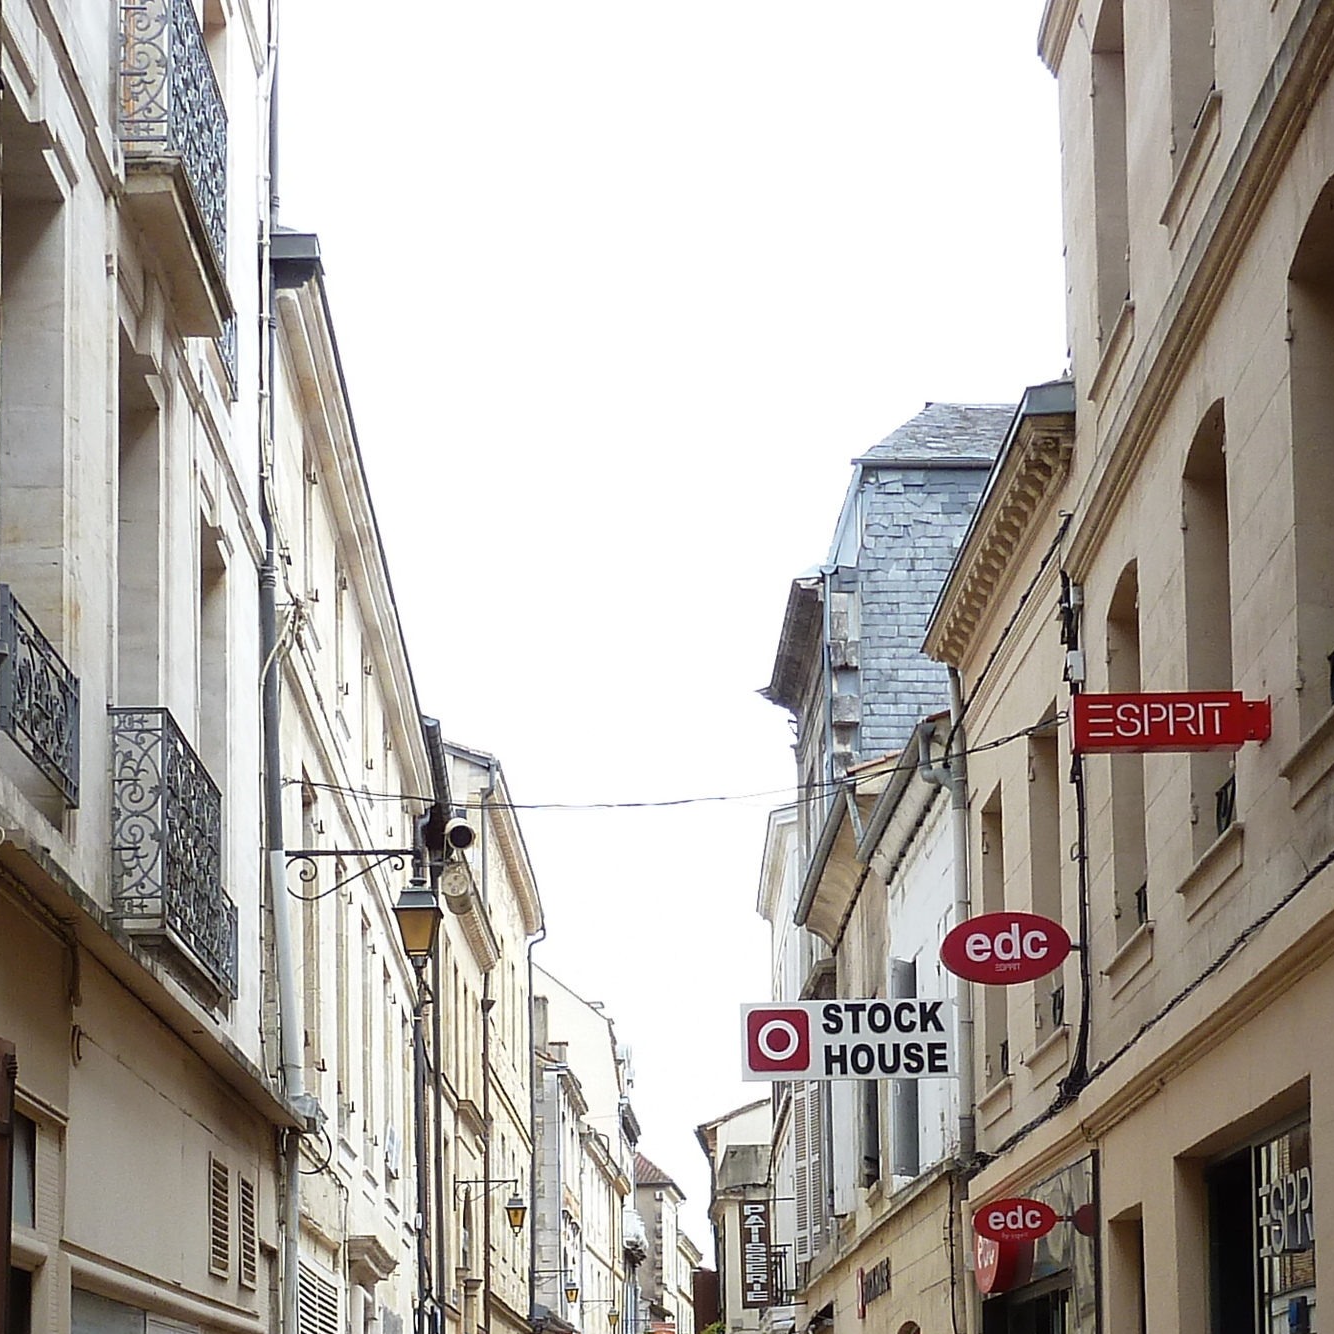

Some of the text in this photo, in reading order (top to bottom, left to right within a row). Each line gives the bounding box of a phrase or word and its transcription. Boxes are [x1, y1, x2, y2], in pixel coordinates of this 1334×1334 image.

[1087, 702, 1230, 737] ESPRIT
[965, 922, 1049, 962] edc
[822, 1001, 945, 1034] STOCK
[824, 1042, 949, 1076] HOUSE
[988, 1205, 1042, 1230] edc
[1258, 1166, 1316, 1258] ESPR
[743, 1204, 769, 1302] PATISSERIE
